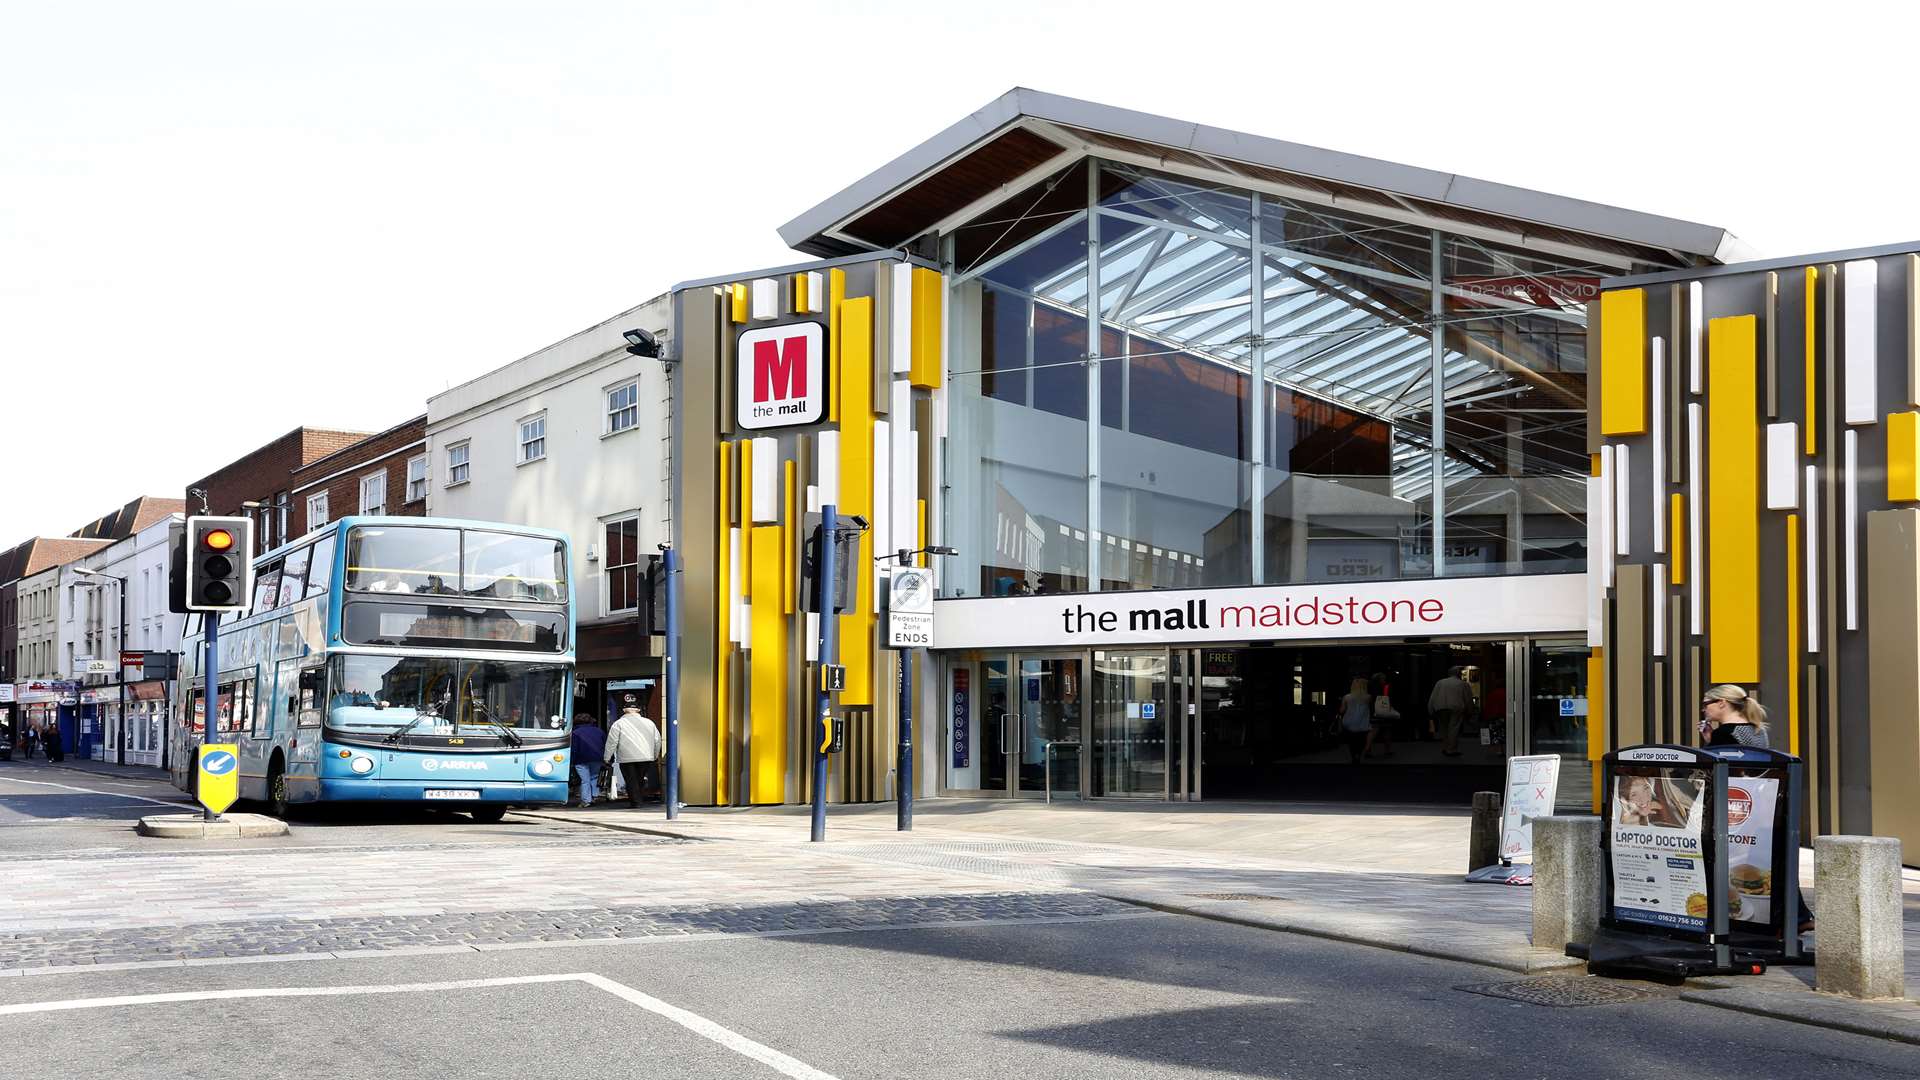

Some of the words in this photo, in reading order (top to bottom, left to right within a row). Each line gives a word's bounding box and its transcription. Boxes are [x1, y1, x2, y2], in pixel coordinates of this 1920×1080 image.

[753, 335, 808, 403] M
[753, 406, 774, 418] the
[778, 400, 807, 415] mall
[892, 614, 932, 623] Pedestrian
[1062, 604, 1118, 634] the
[1129, 599, 1210, 631] mall
[1220, 596, 1444, 628] maidstone
[903, 622, 921, 631] Zone
[895, 633, 929, 643] ENDS
[1209, 652, 1233, 663] FREE
[1632, 752, 1655, 760] LAPTOP
[1656, 753, 1679, 761] DOCTOR
[440, 760, 488, 770] ARRIVA
[1616, 831, 1653, 845] LAPTOP
[1655, 835, 1697, 849] DOCTOR
[1657, 914, 1677, 923] 01622
